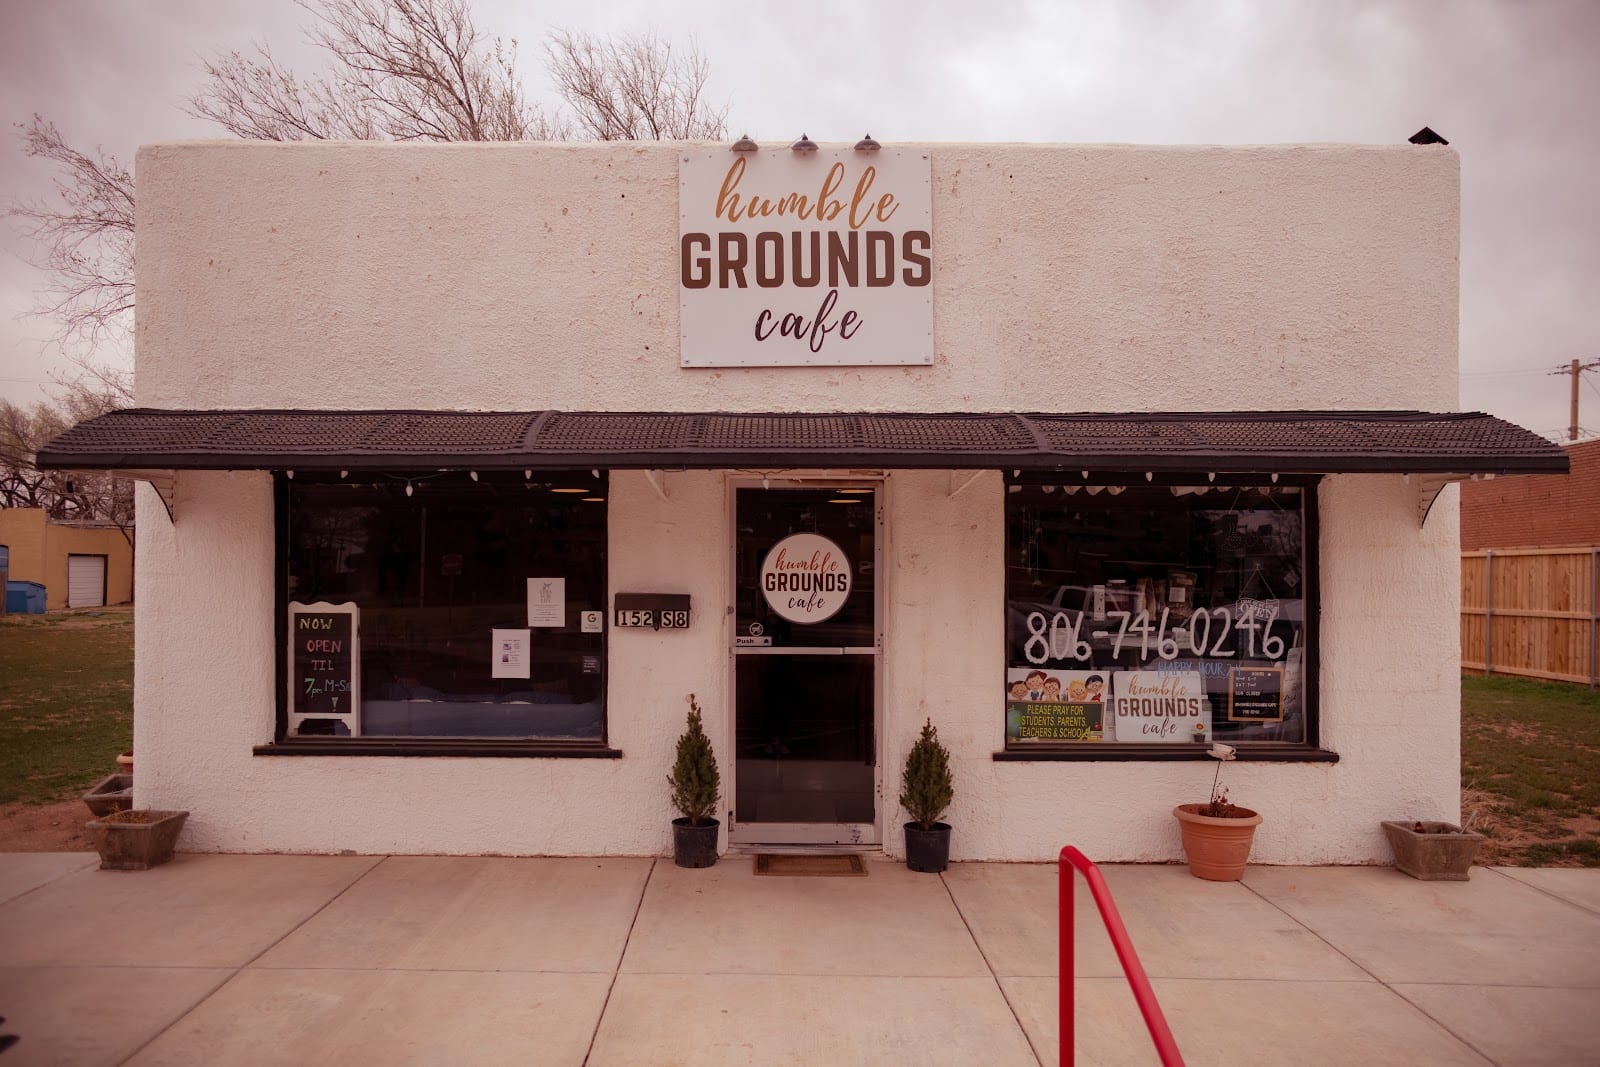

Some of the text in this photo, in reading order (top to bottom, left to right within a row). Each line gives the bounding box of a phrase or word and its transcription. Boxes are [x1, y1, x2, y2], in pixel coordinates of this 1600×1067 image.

[715, 157, 900, 230] humble
[681, 230, 932, 290] GROUNDS
[754, 289, 864, 353] cafe
[775, 547, 839, 574] humble
[765, 572, 847, 592] GROUNDS
[788, 590, 826, 613] cafe
[300, 618, 333, 630] NOW
[621, 611, 686, 627] 152 S8
[306, 639, 342, 653] OPEN
[311, 659, 334, 671] TIL
[1157, 661, 1193, 675] HAPPY
[1198, 662, 1223, 676] HOUR
[1128, 674, 1187, 697] humble
[1027, 704, 1084, 716] PLEASE PRAY FOR
[1117, 697, 1199, 717] GROUNDS
[1019, 726, 1051, 737] TEACHERS
[1053, 727, 1058, 738] &
[1142, 717, 1178, 738] cafe
